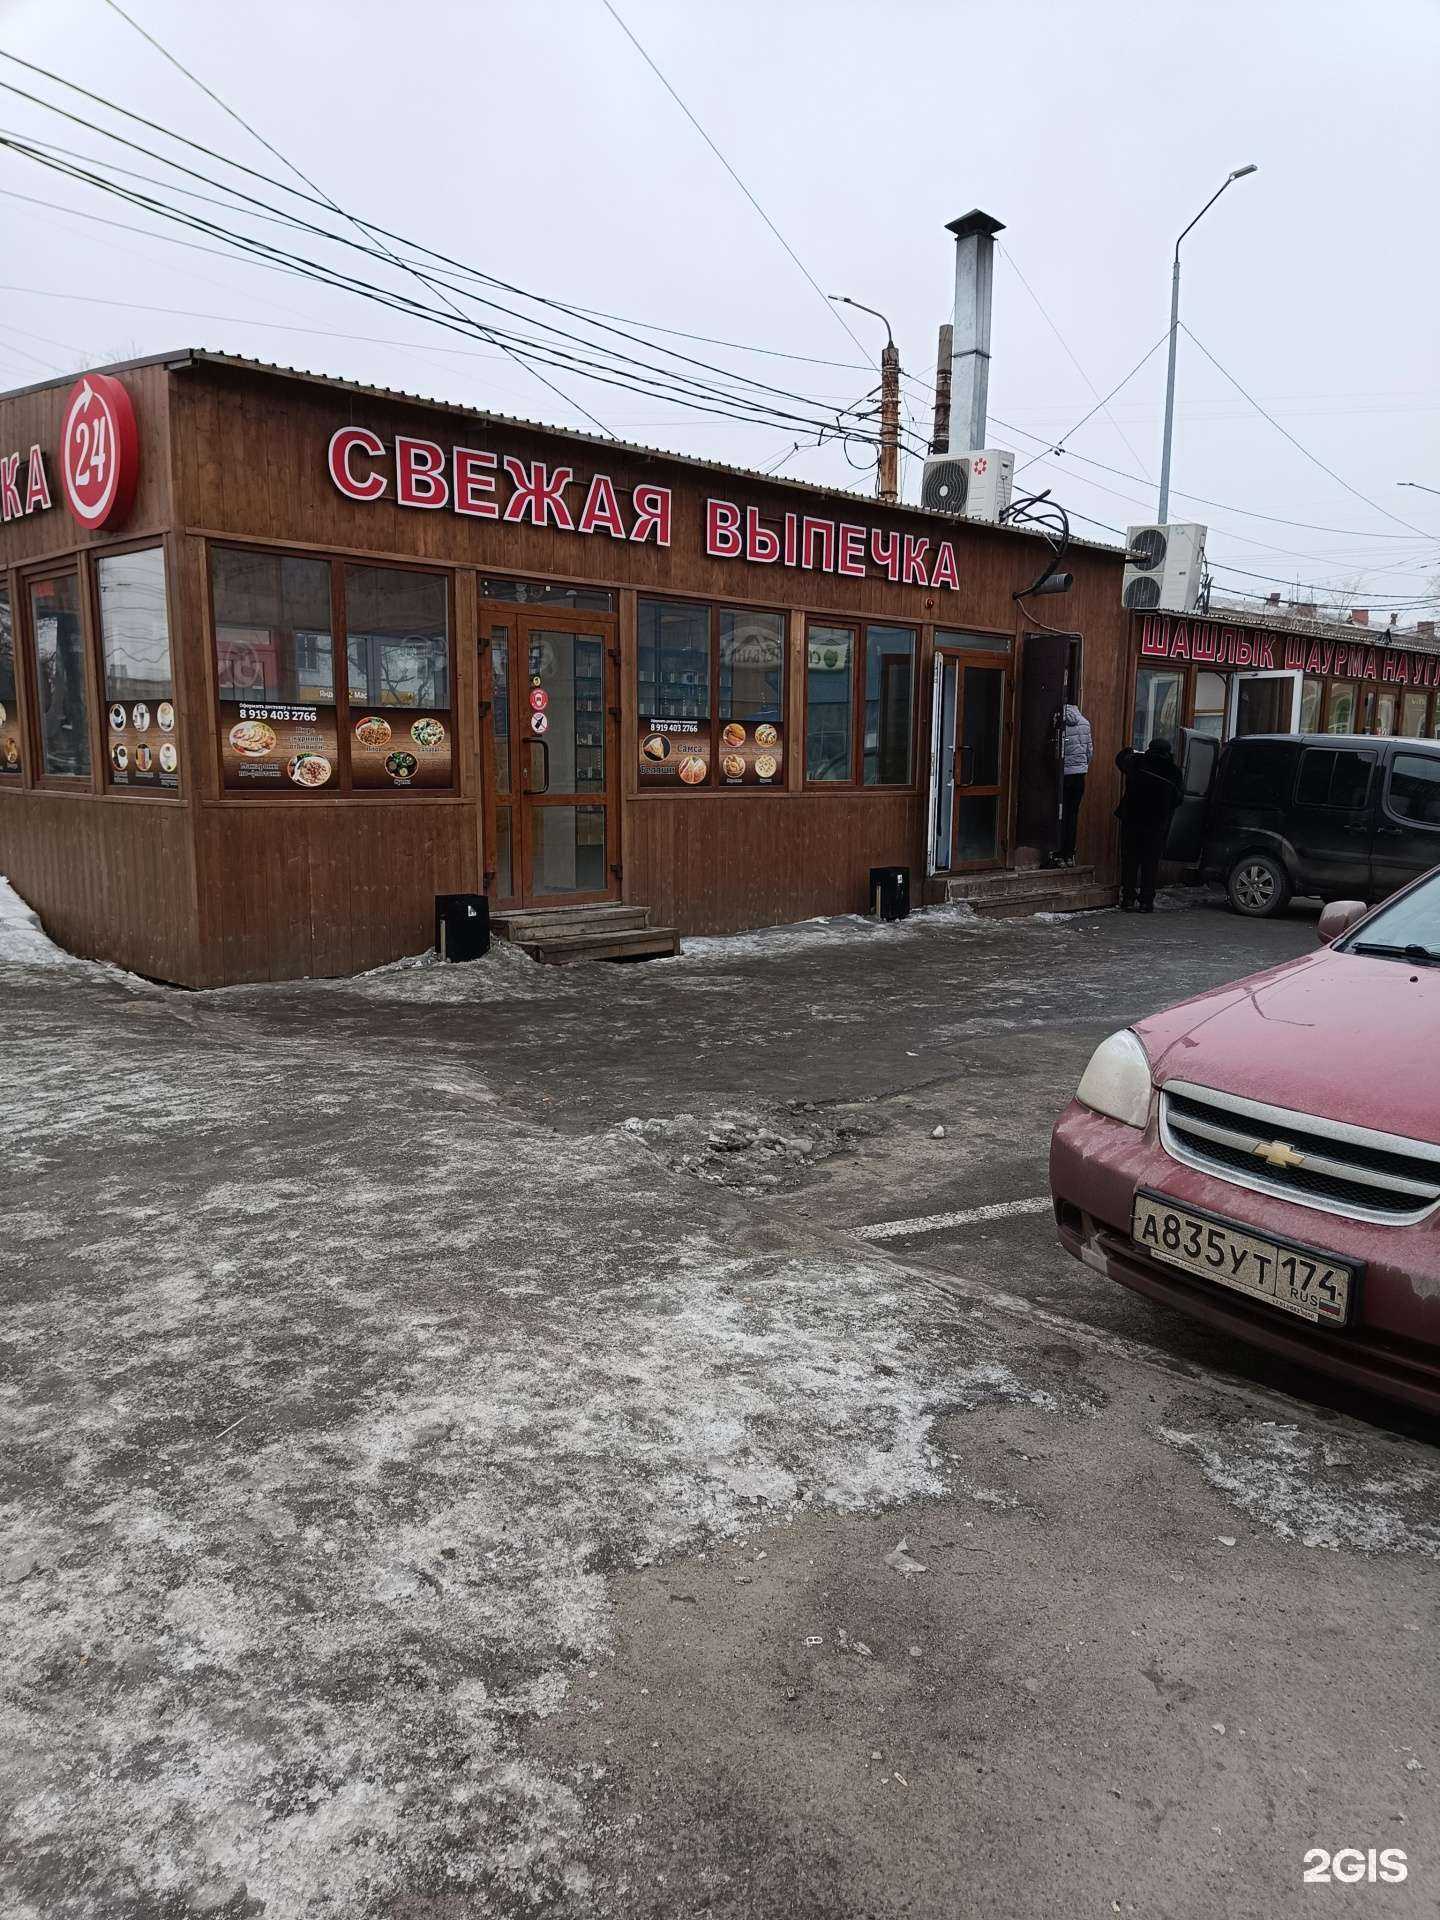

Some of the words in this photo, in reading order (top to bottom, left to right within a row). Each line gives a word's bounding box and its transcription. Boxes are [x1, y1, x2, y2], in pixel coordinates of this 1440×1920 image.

[0, 443, 52, 522] КА
[76, 416, 106, 486] 24
[328, 426, 672, 547] СВЕЖАЯ
[706, 498, 960, 591] ВЫПЕЧКА
[1141, 615, 1277, 669] ШАШЛЫК
[1285, 636, 1377, 681] ШАУРМА
[1383, 650, 1408, 684] НА
[240, 709, 247, 719] 8
[248, 709, 268, 720] 919
[270, 710, 290, 721] 403
[292, 711, 317, 722] 2766
[650, 723, 655, 731] 8
[656, 724, 668, 732] 919
[669, 724, 681, 732] 403
[682, 725, 698, 733] 2766
[677, 743, 703, 753] Самса
[1141, 1213, 1272, 1285] А835УТ
[1281, 1256, 1338, 1301] 174
[1290, 1287, 1319, 1307] RUS
